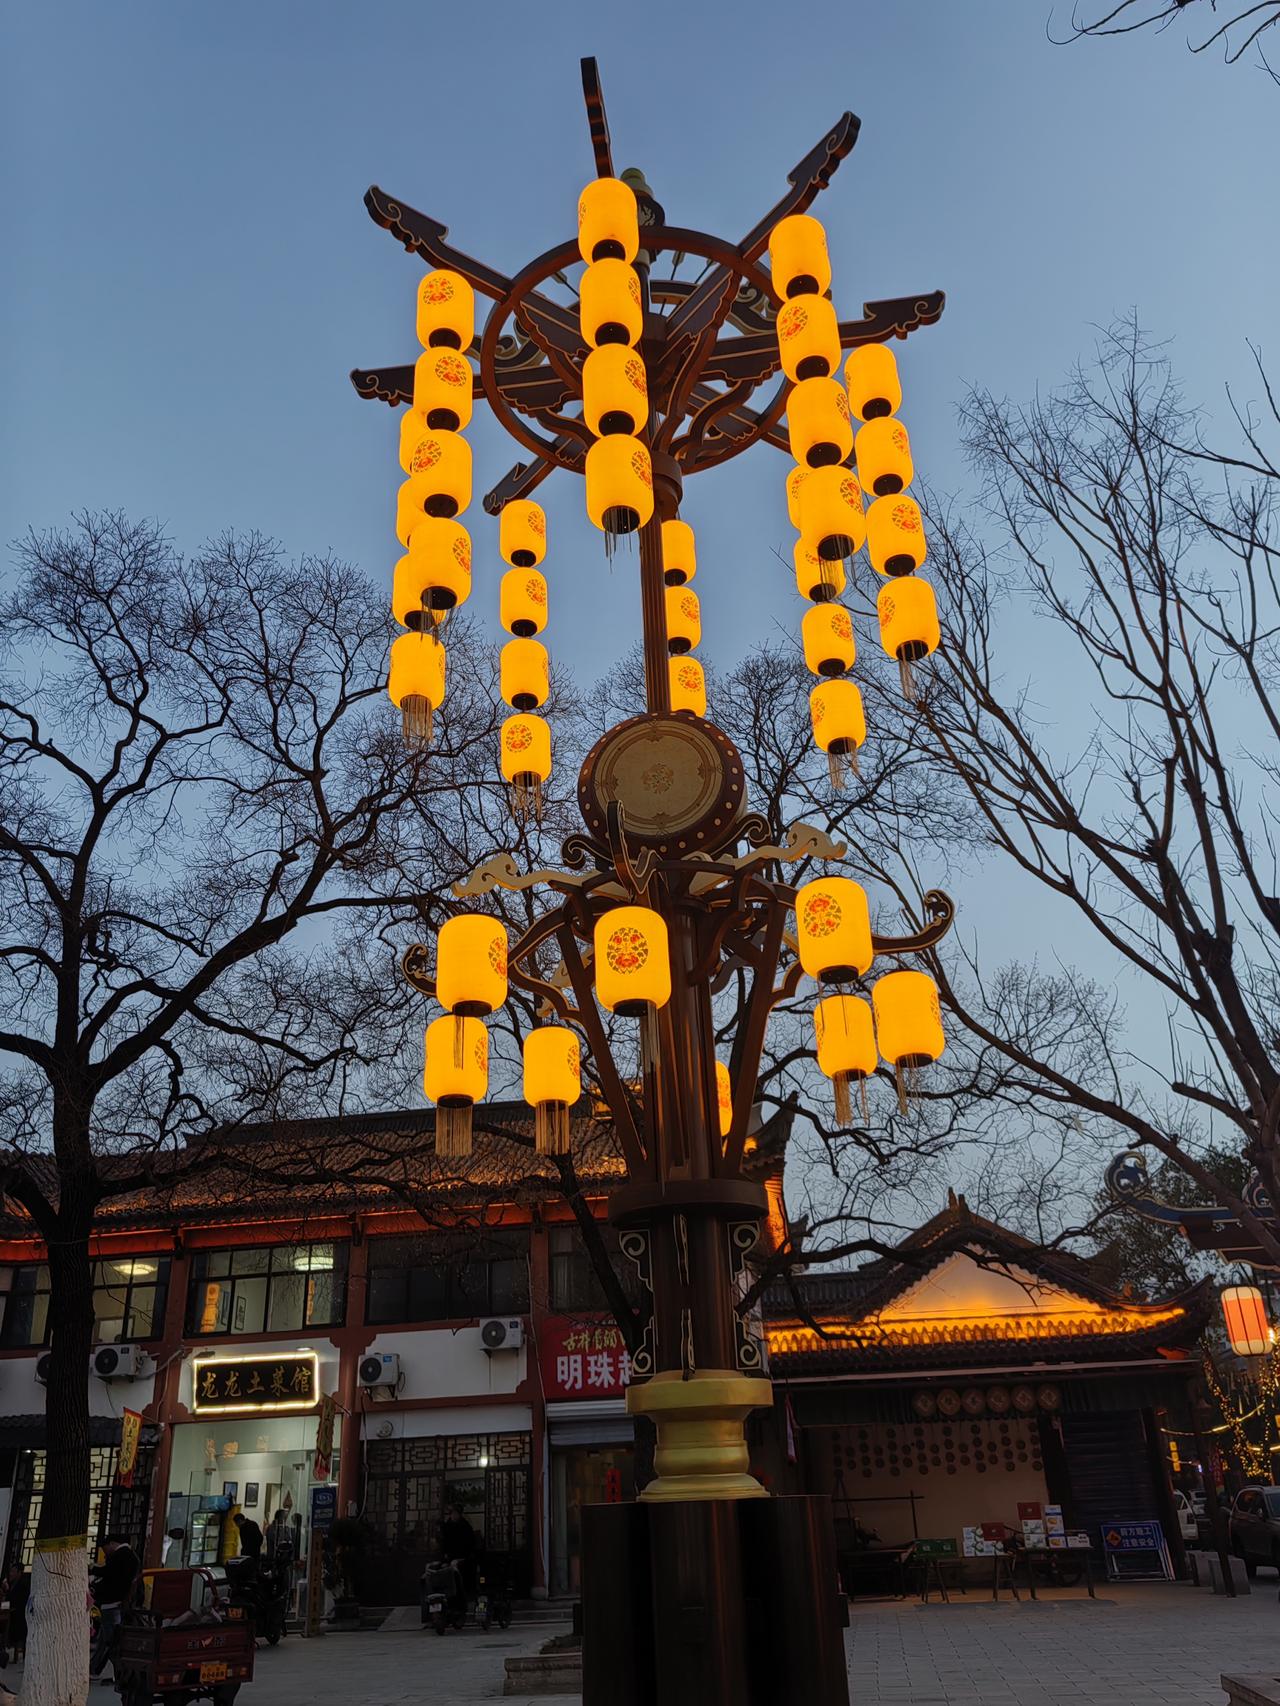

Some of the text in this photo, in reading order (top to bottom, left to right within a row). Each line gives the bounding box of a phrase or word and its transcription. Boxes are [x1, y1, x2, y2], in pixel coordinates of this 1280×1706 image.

[201, 1366, 311, 1398] 龙龙土菜馆
[1122, 1538, 1154, 1547] 注意安全
